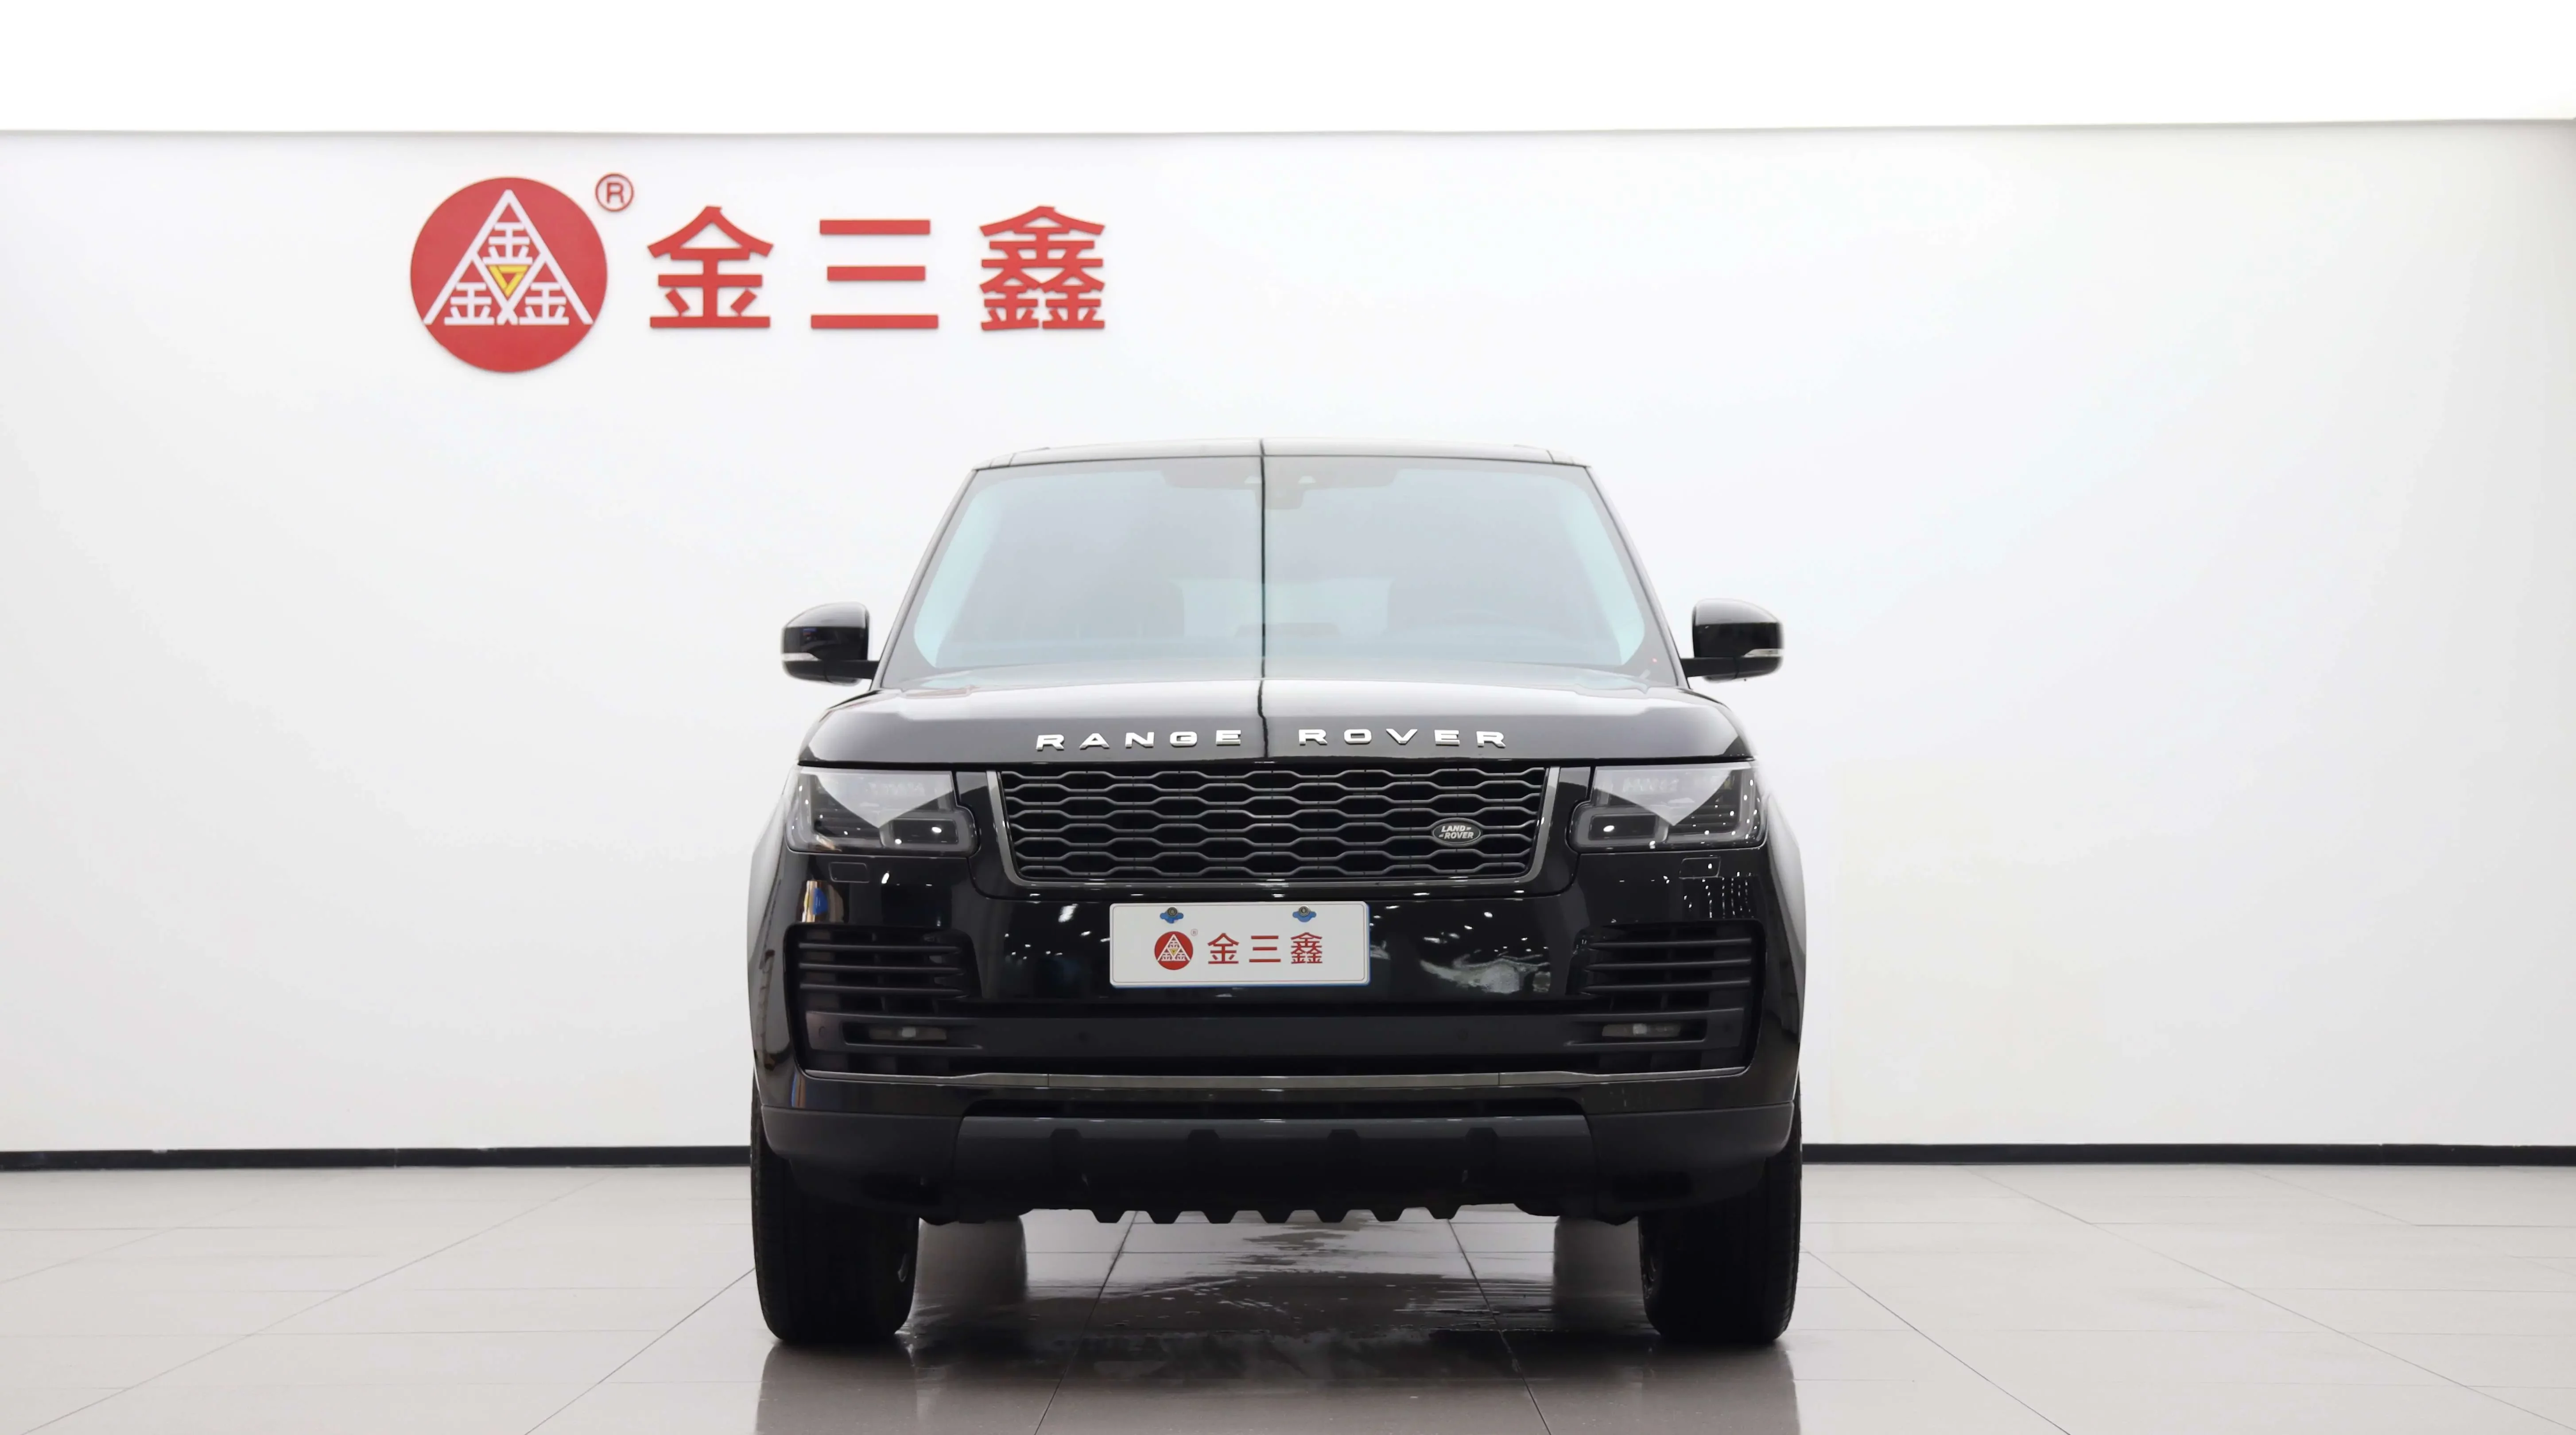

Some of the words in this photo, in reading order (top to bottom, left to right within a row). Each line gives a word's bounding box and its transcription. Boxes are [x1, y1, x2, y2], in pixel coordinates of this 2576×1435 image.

[647, 206, 1105, 331] 金三鑫
[1036, 730, 1241, 751] RANGE
[1299, 729, 1506, 748] ROVER
[1208, 932, 1323, 965] 金三鑫
